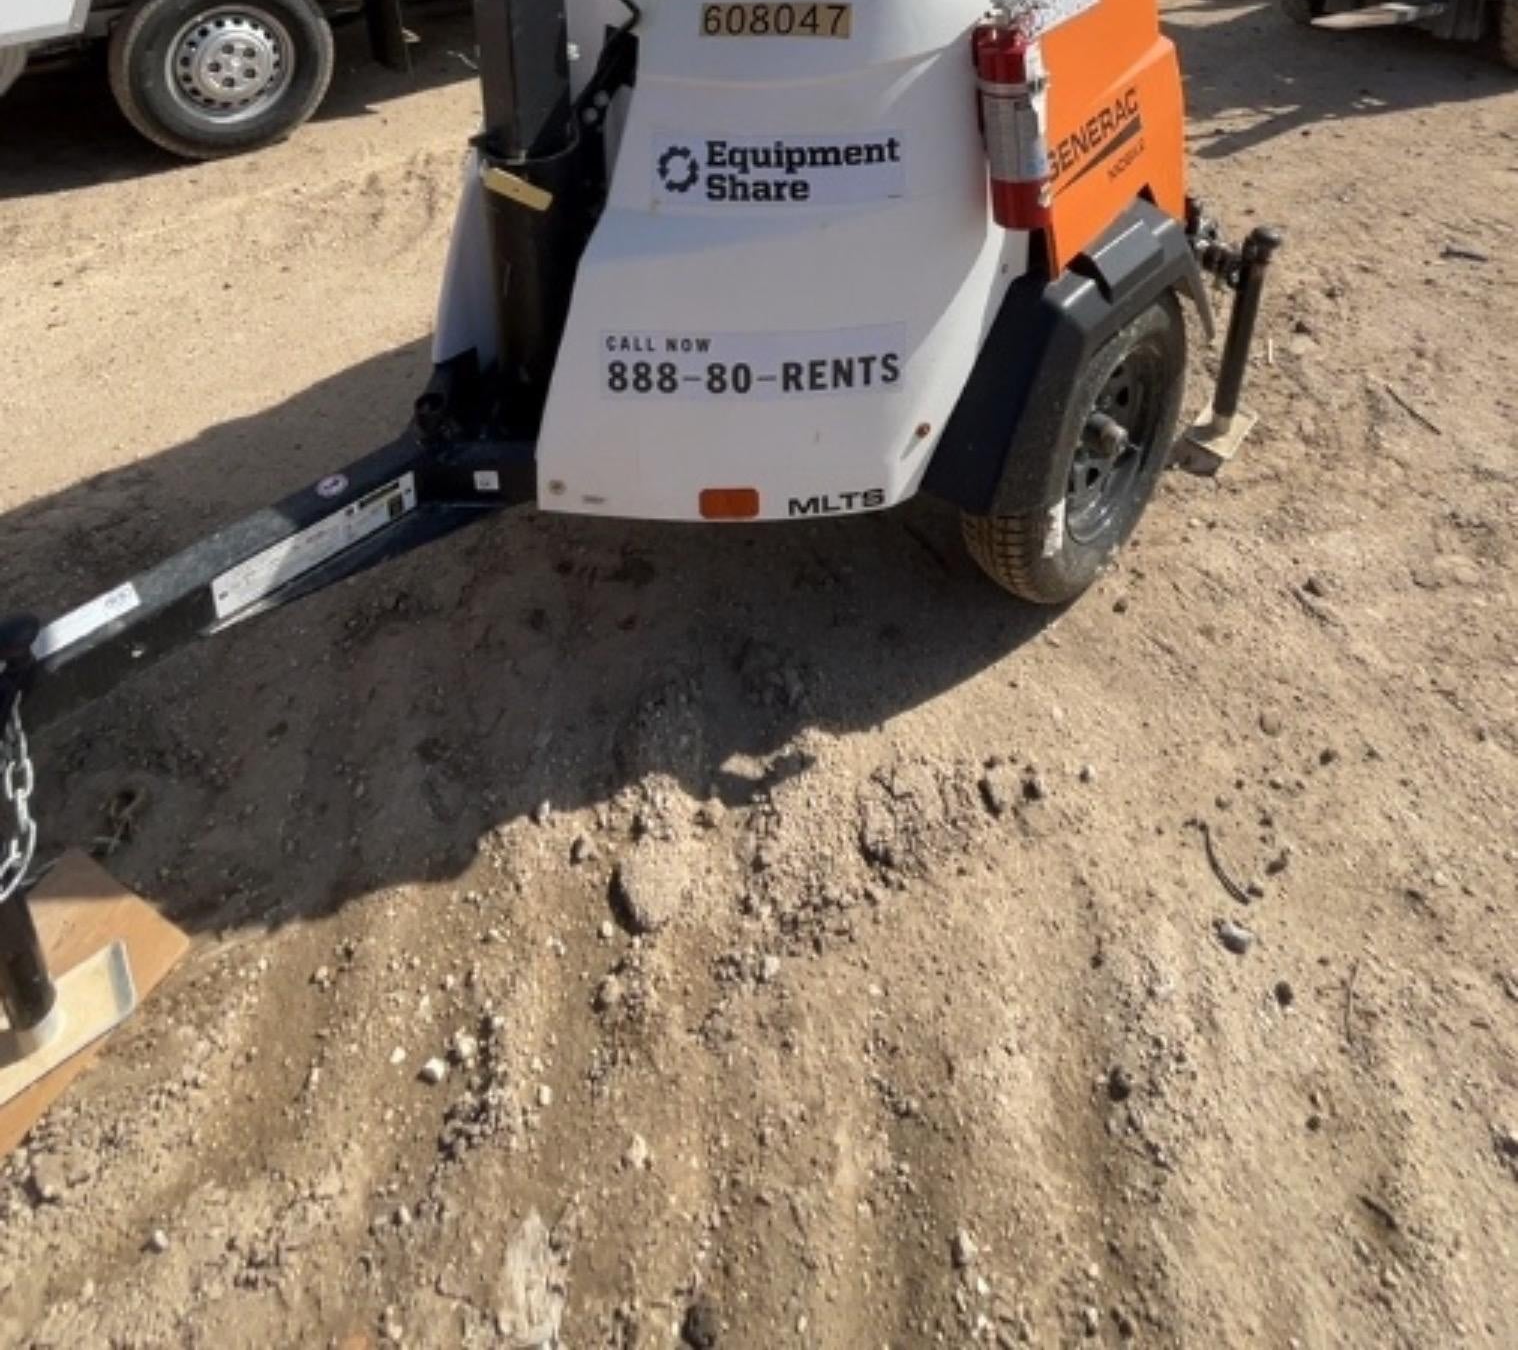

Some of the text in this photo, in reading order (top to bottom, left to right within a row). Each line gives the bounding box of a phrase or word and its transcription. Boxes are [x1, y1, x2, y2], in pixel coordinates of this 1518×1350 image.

[704, 3, 848, 36] 608047
[706, 138, 900, 175] Equipment
[706, 173, 810, 201] Share
[606, 336, 711, 352] CALL NOW
[608, 353, 900, 393] 888-80-RENTS
